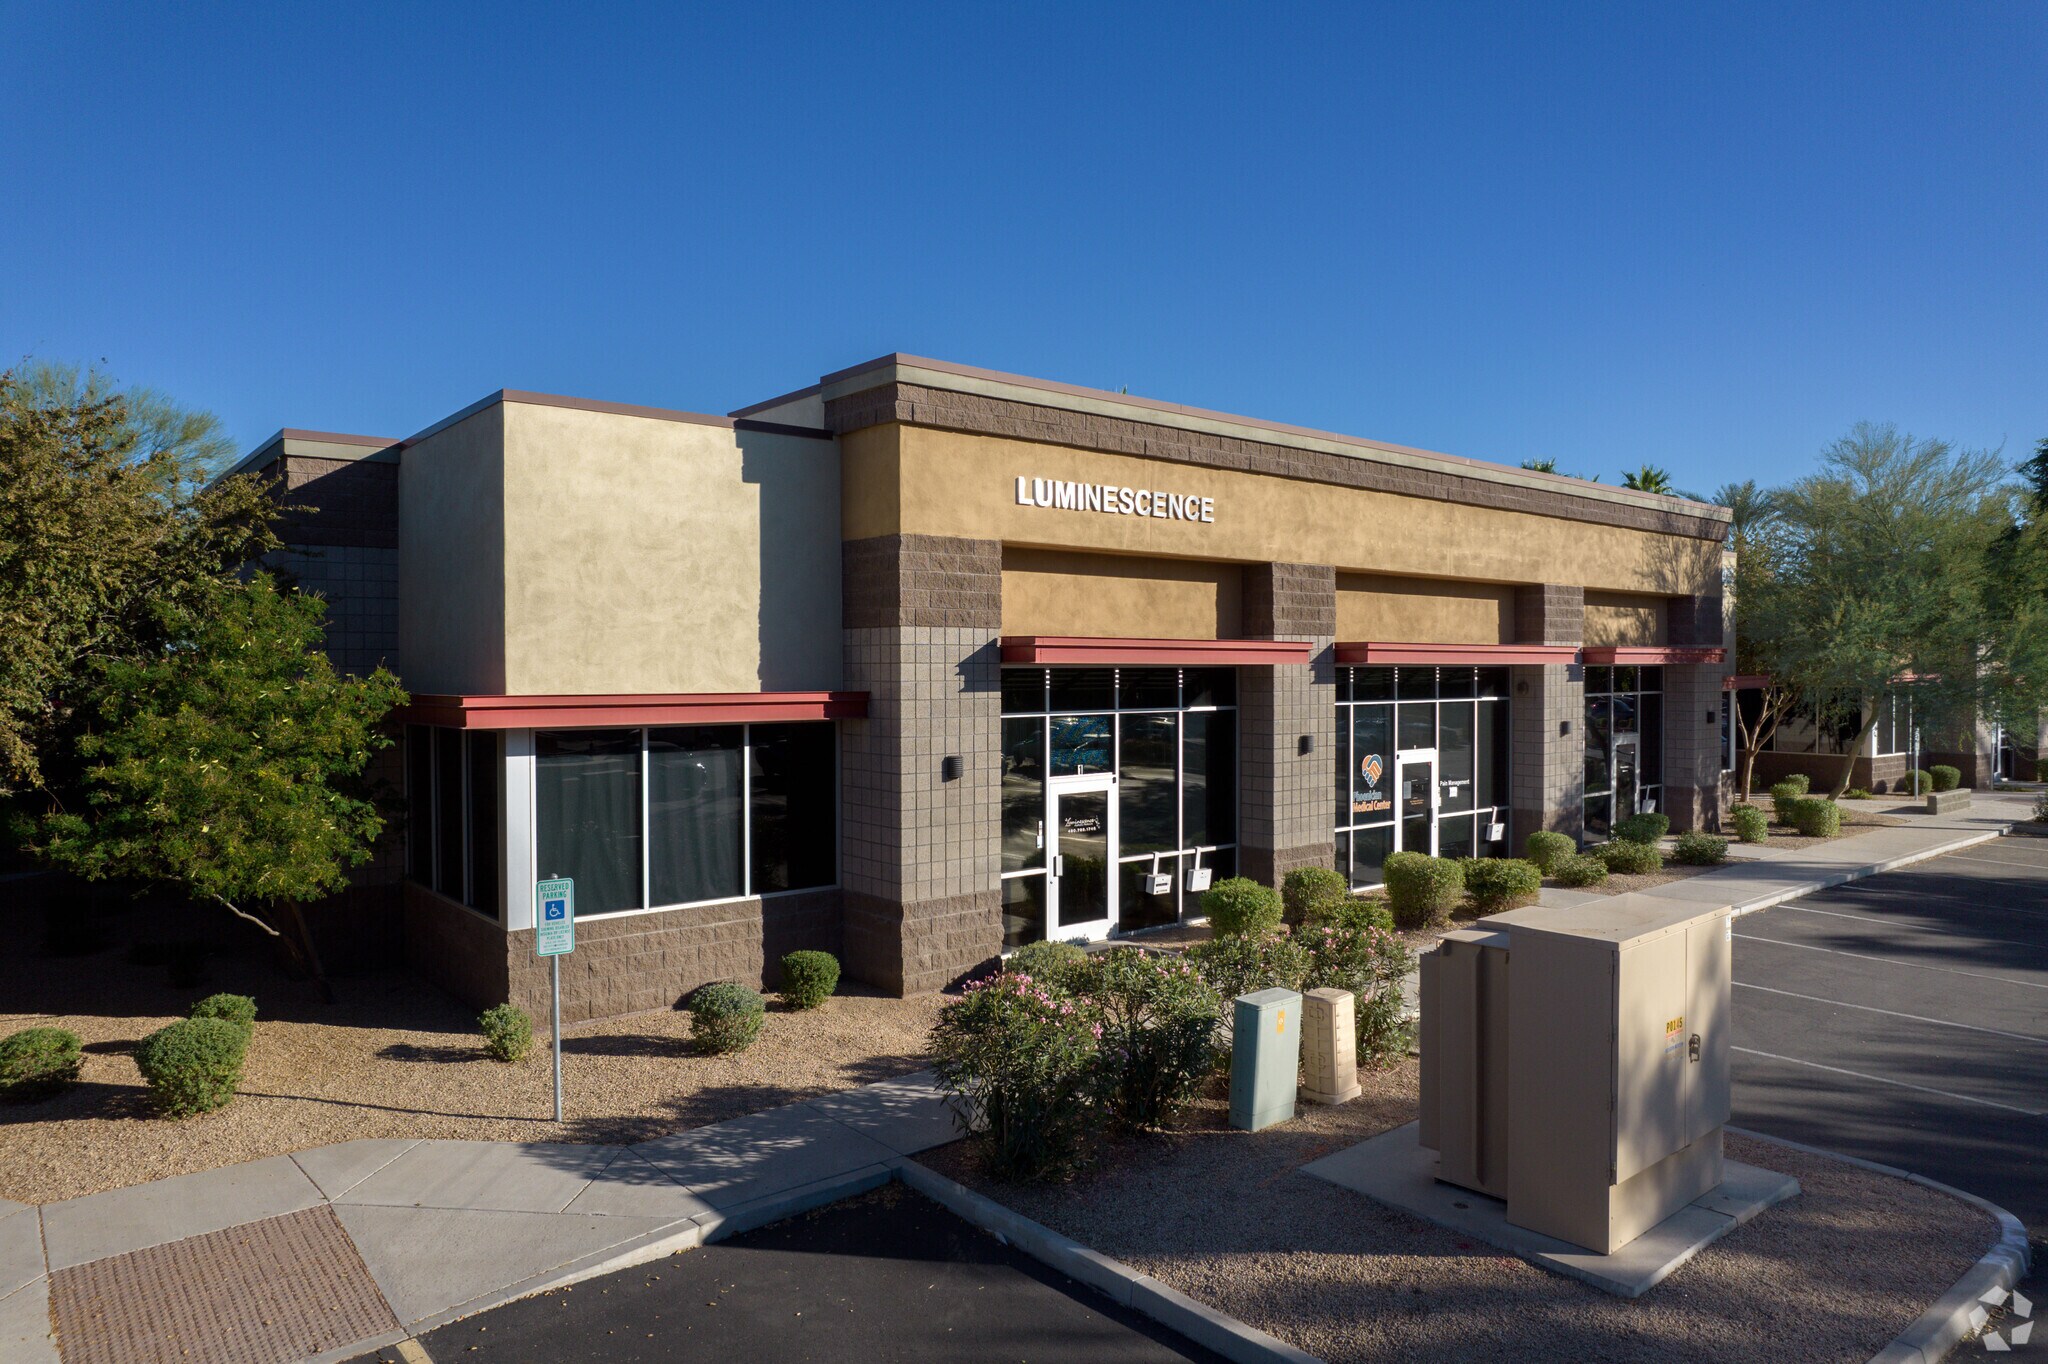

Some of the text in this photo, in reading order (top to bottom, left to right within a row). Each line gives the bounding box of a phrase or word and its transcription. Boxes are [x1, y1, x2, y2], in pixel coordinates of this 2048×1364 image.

[1015, 475, 1215, 523] LUMINESCENCE
[1374, 799, 1391, 811] Center
[540, 882, 569, 893] RESERVED
[542, 890, 567, 900] PARKING
